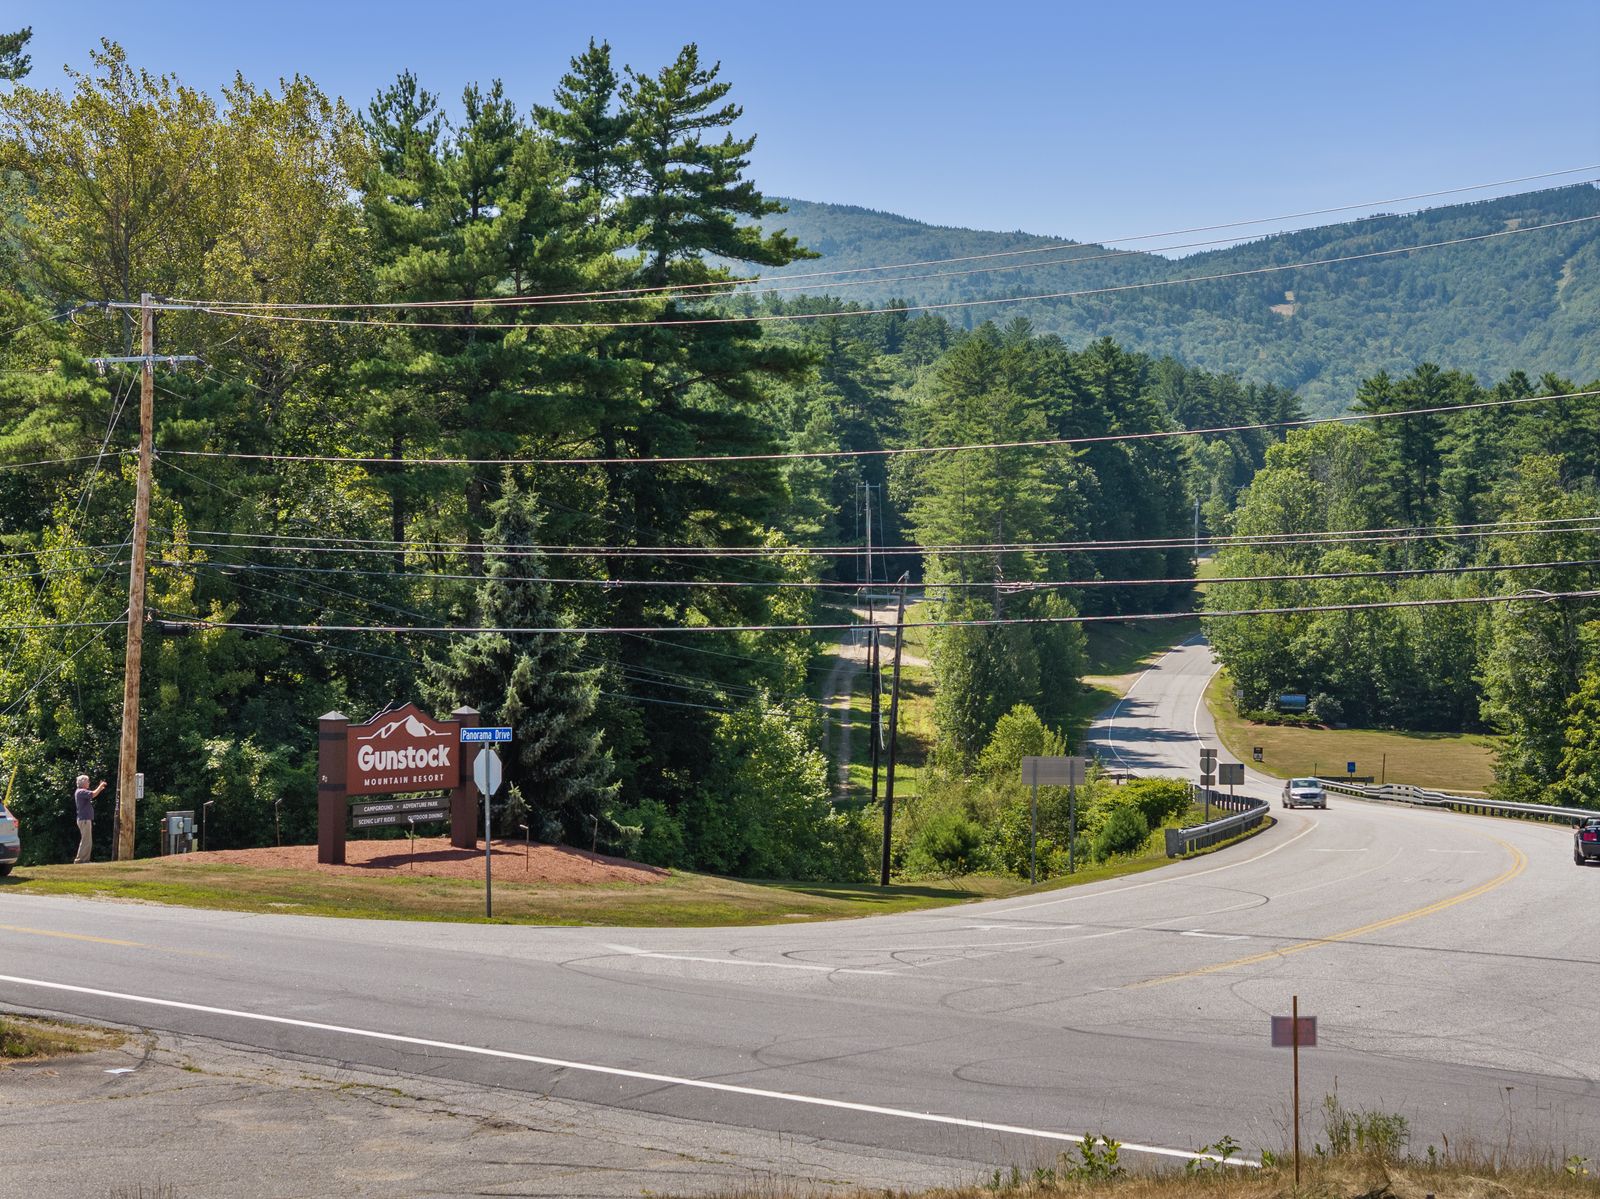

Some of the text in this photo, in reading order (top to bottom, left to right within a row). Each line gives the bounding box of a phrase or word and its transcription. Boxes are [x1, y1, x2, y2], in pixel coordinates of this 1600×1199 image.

[462, 729, 510, 740] Panorama Drive
[358, 744, 450, 771] Gunstock
[364, 774, 444, 786] MOUNTAIN RESORT
[364, 804, 394, 812] CAMPGROUND
[407, 813, 428, 821] OUTDOOR
